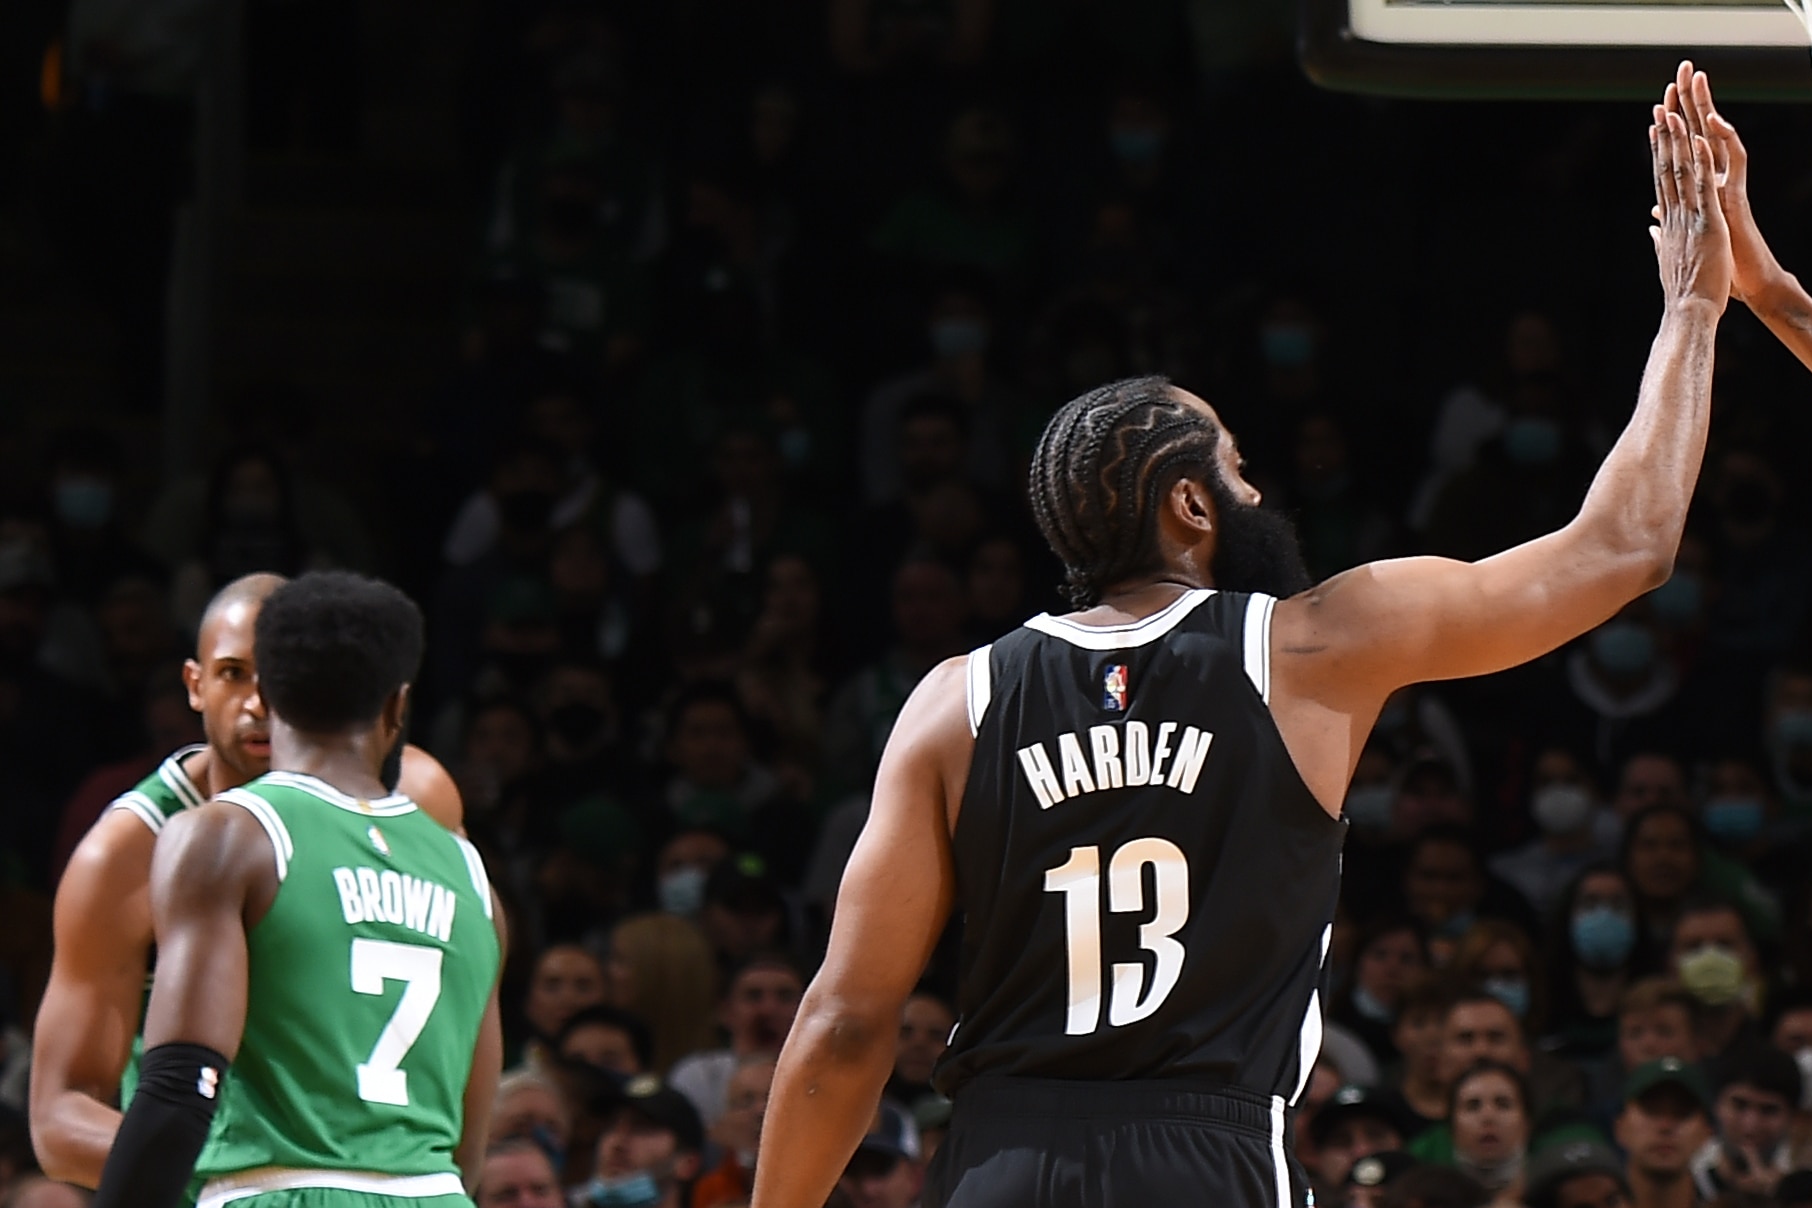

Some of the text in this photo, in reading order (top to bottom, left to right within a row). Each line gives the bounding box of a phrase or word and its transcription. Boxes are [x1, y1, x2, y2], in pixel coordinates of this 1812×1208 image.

[1017, 720, 1214, 810] HARDEN
[332, 866, 456, 943] BROWN
[1043, 837, 1190, 1036] 13
[351, 937, 444, 1107] 7
